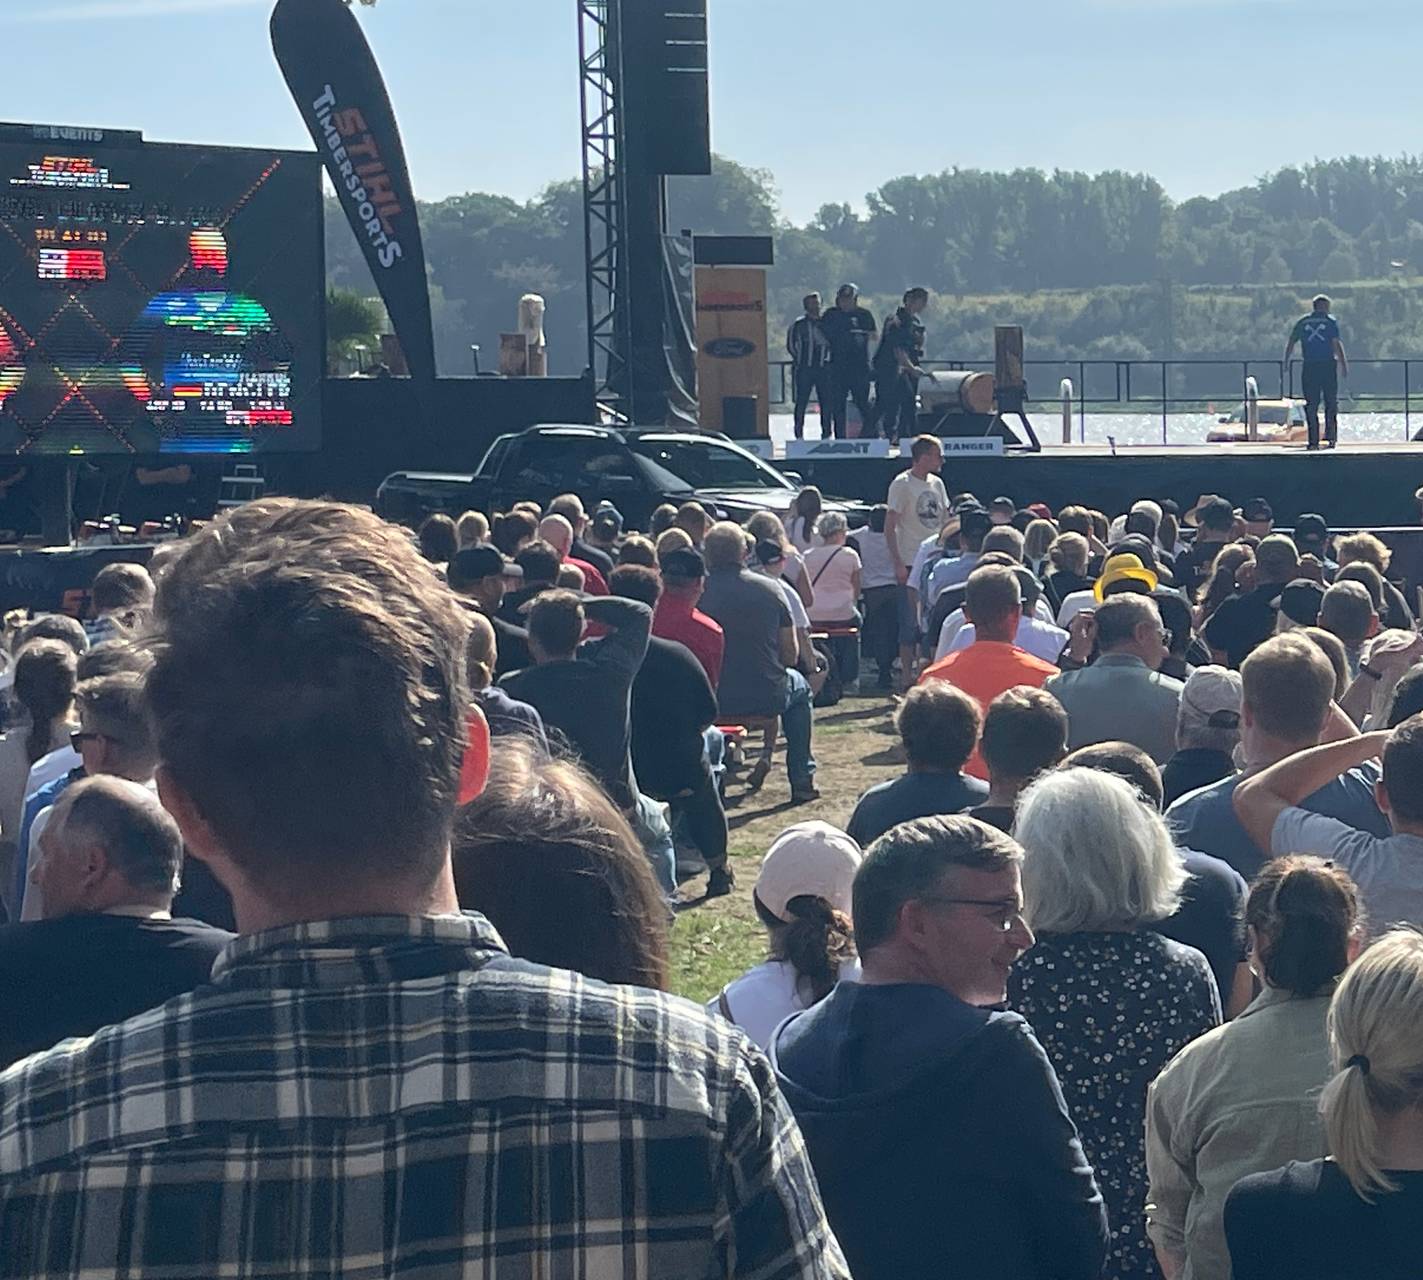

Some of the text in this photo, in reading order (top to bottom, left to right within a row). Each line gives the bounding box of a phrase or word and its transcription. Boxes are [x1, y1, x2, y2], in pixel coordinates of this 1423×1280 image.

[312, 84, 402, 268] TIMBERSPORTS
[333, 107, 402, 235] STIHL
[944, 442, 993, 451] RANGER
